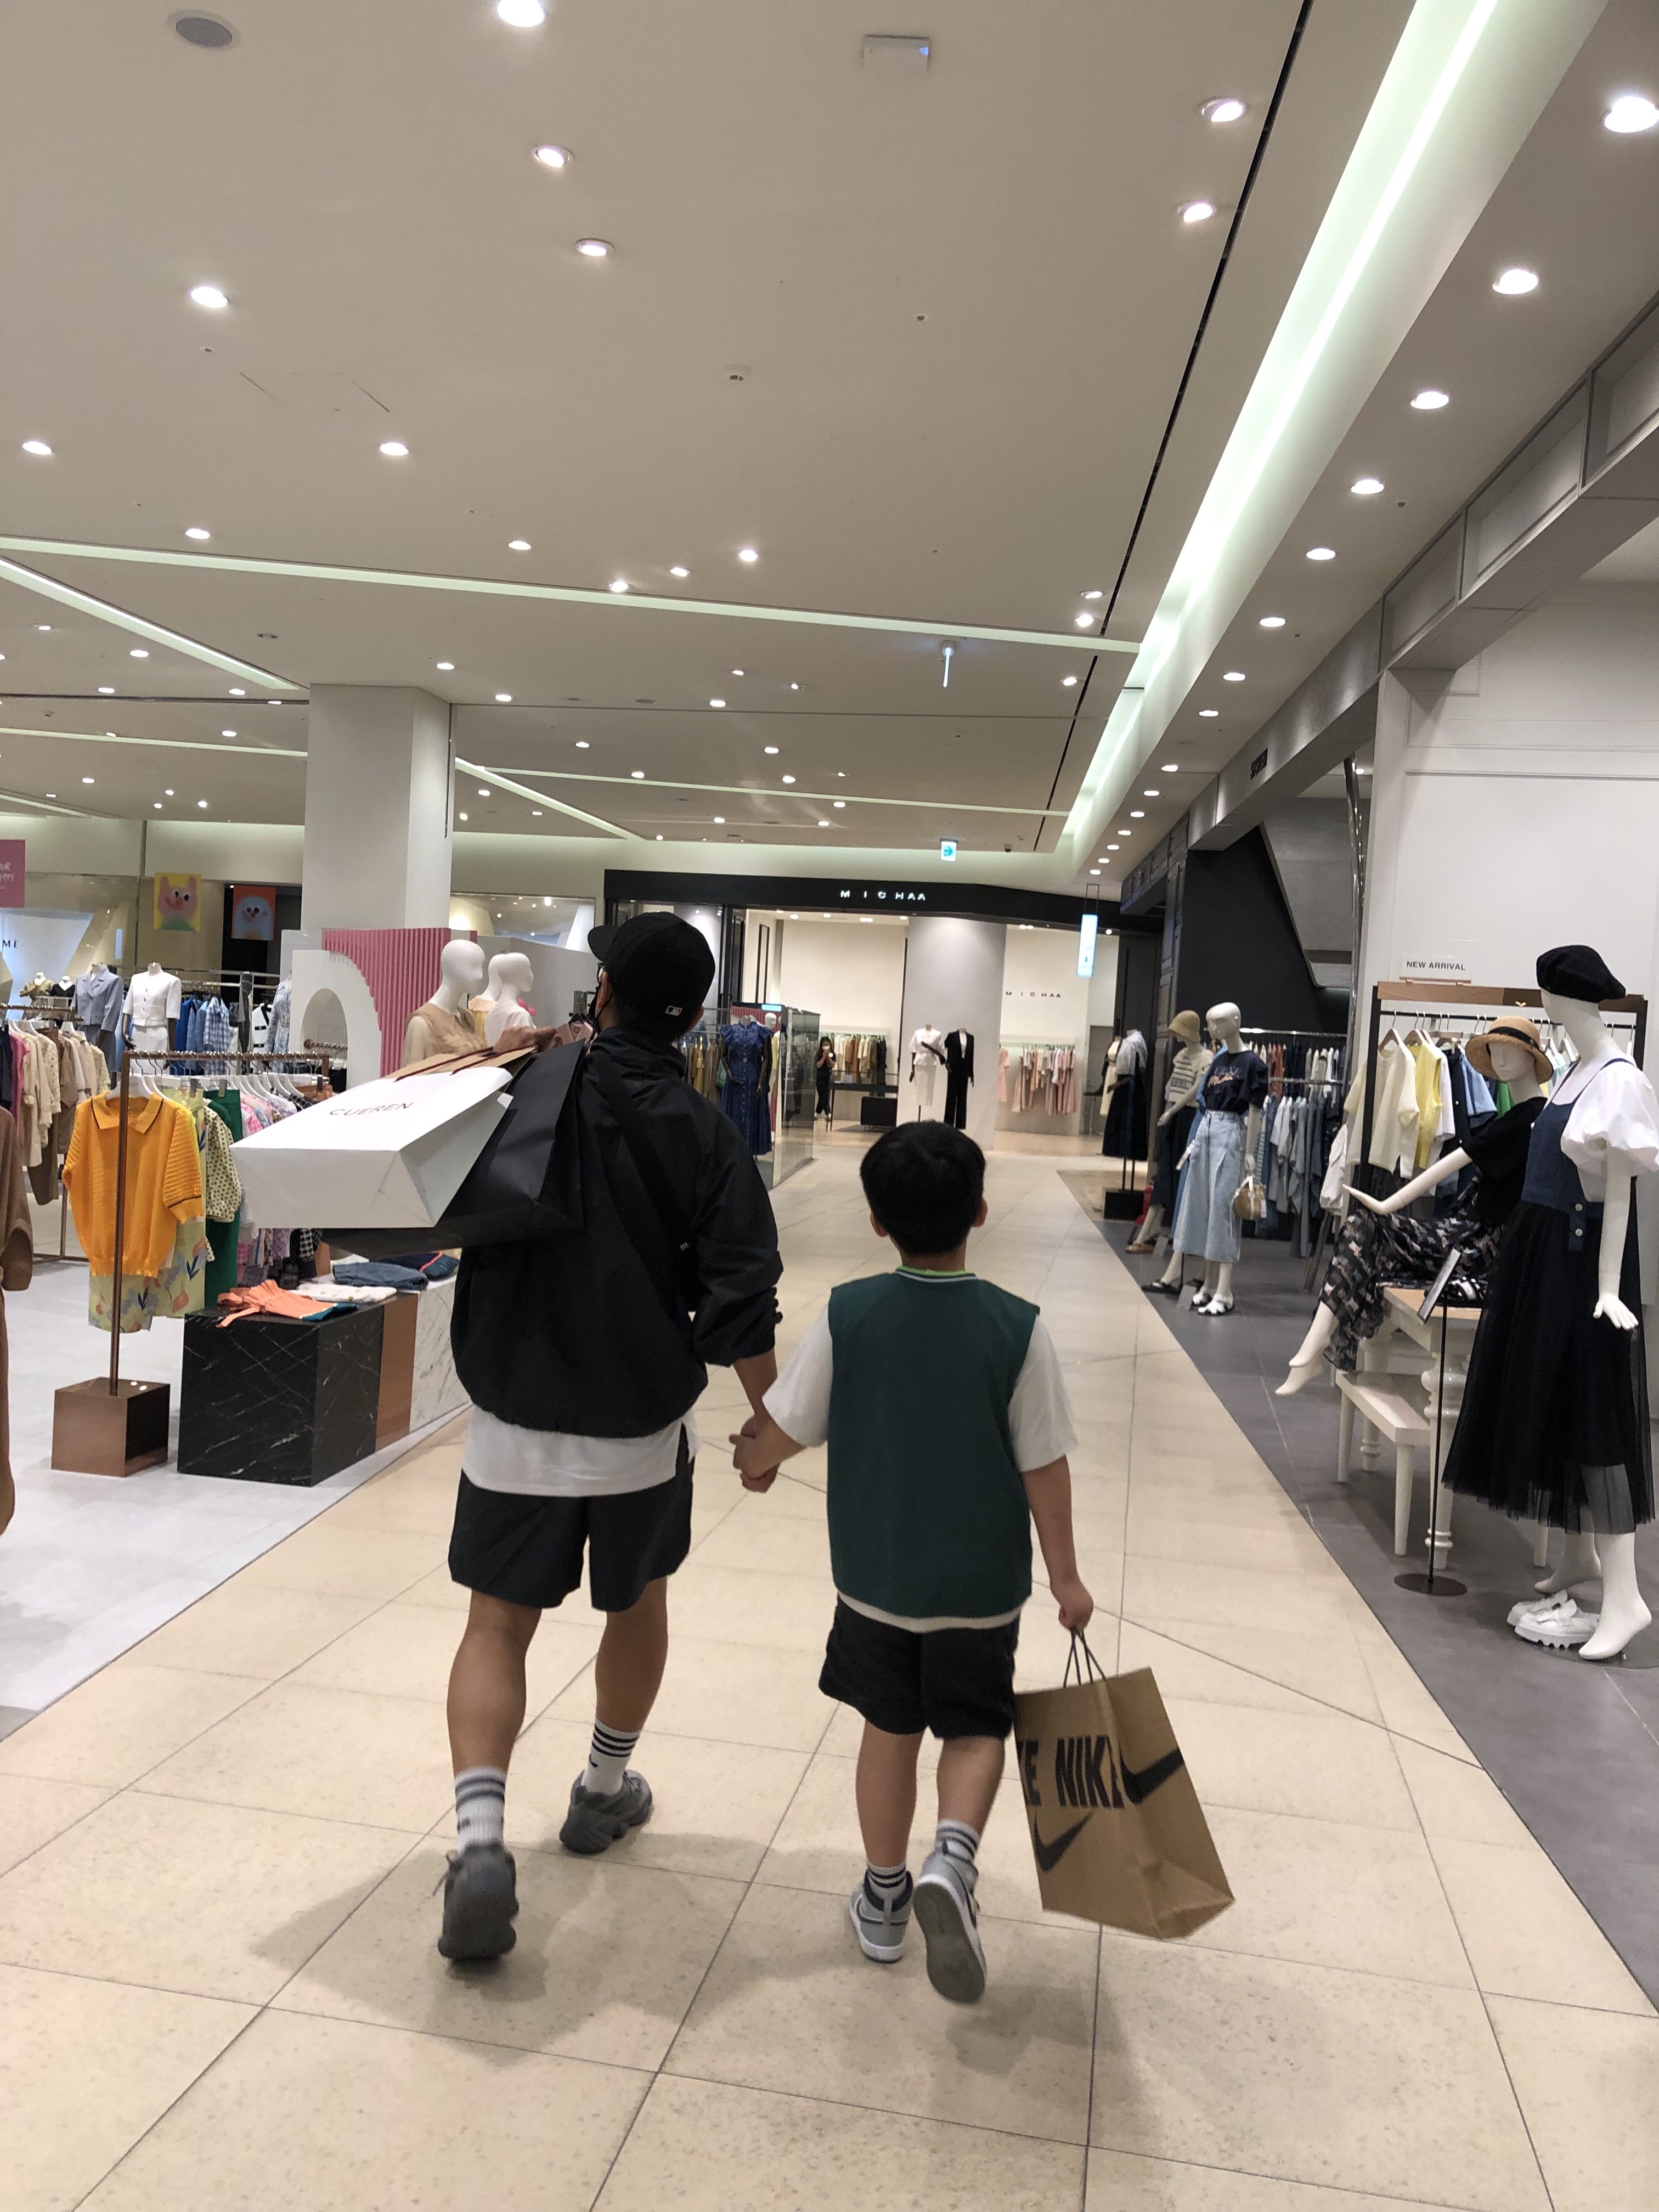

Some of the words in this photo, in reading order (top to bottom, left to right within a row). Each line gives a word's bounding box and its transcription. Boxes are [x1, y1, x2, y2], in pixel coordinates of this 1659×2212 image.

[840, 890, 926, 901] MICHAA
[1429, 962, 1466, 971] ARRIVAL
[330, 1102, 414, 1115] CUEREN
